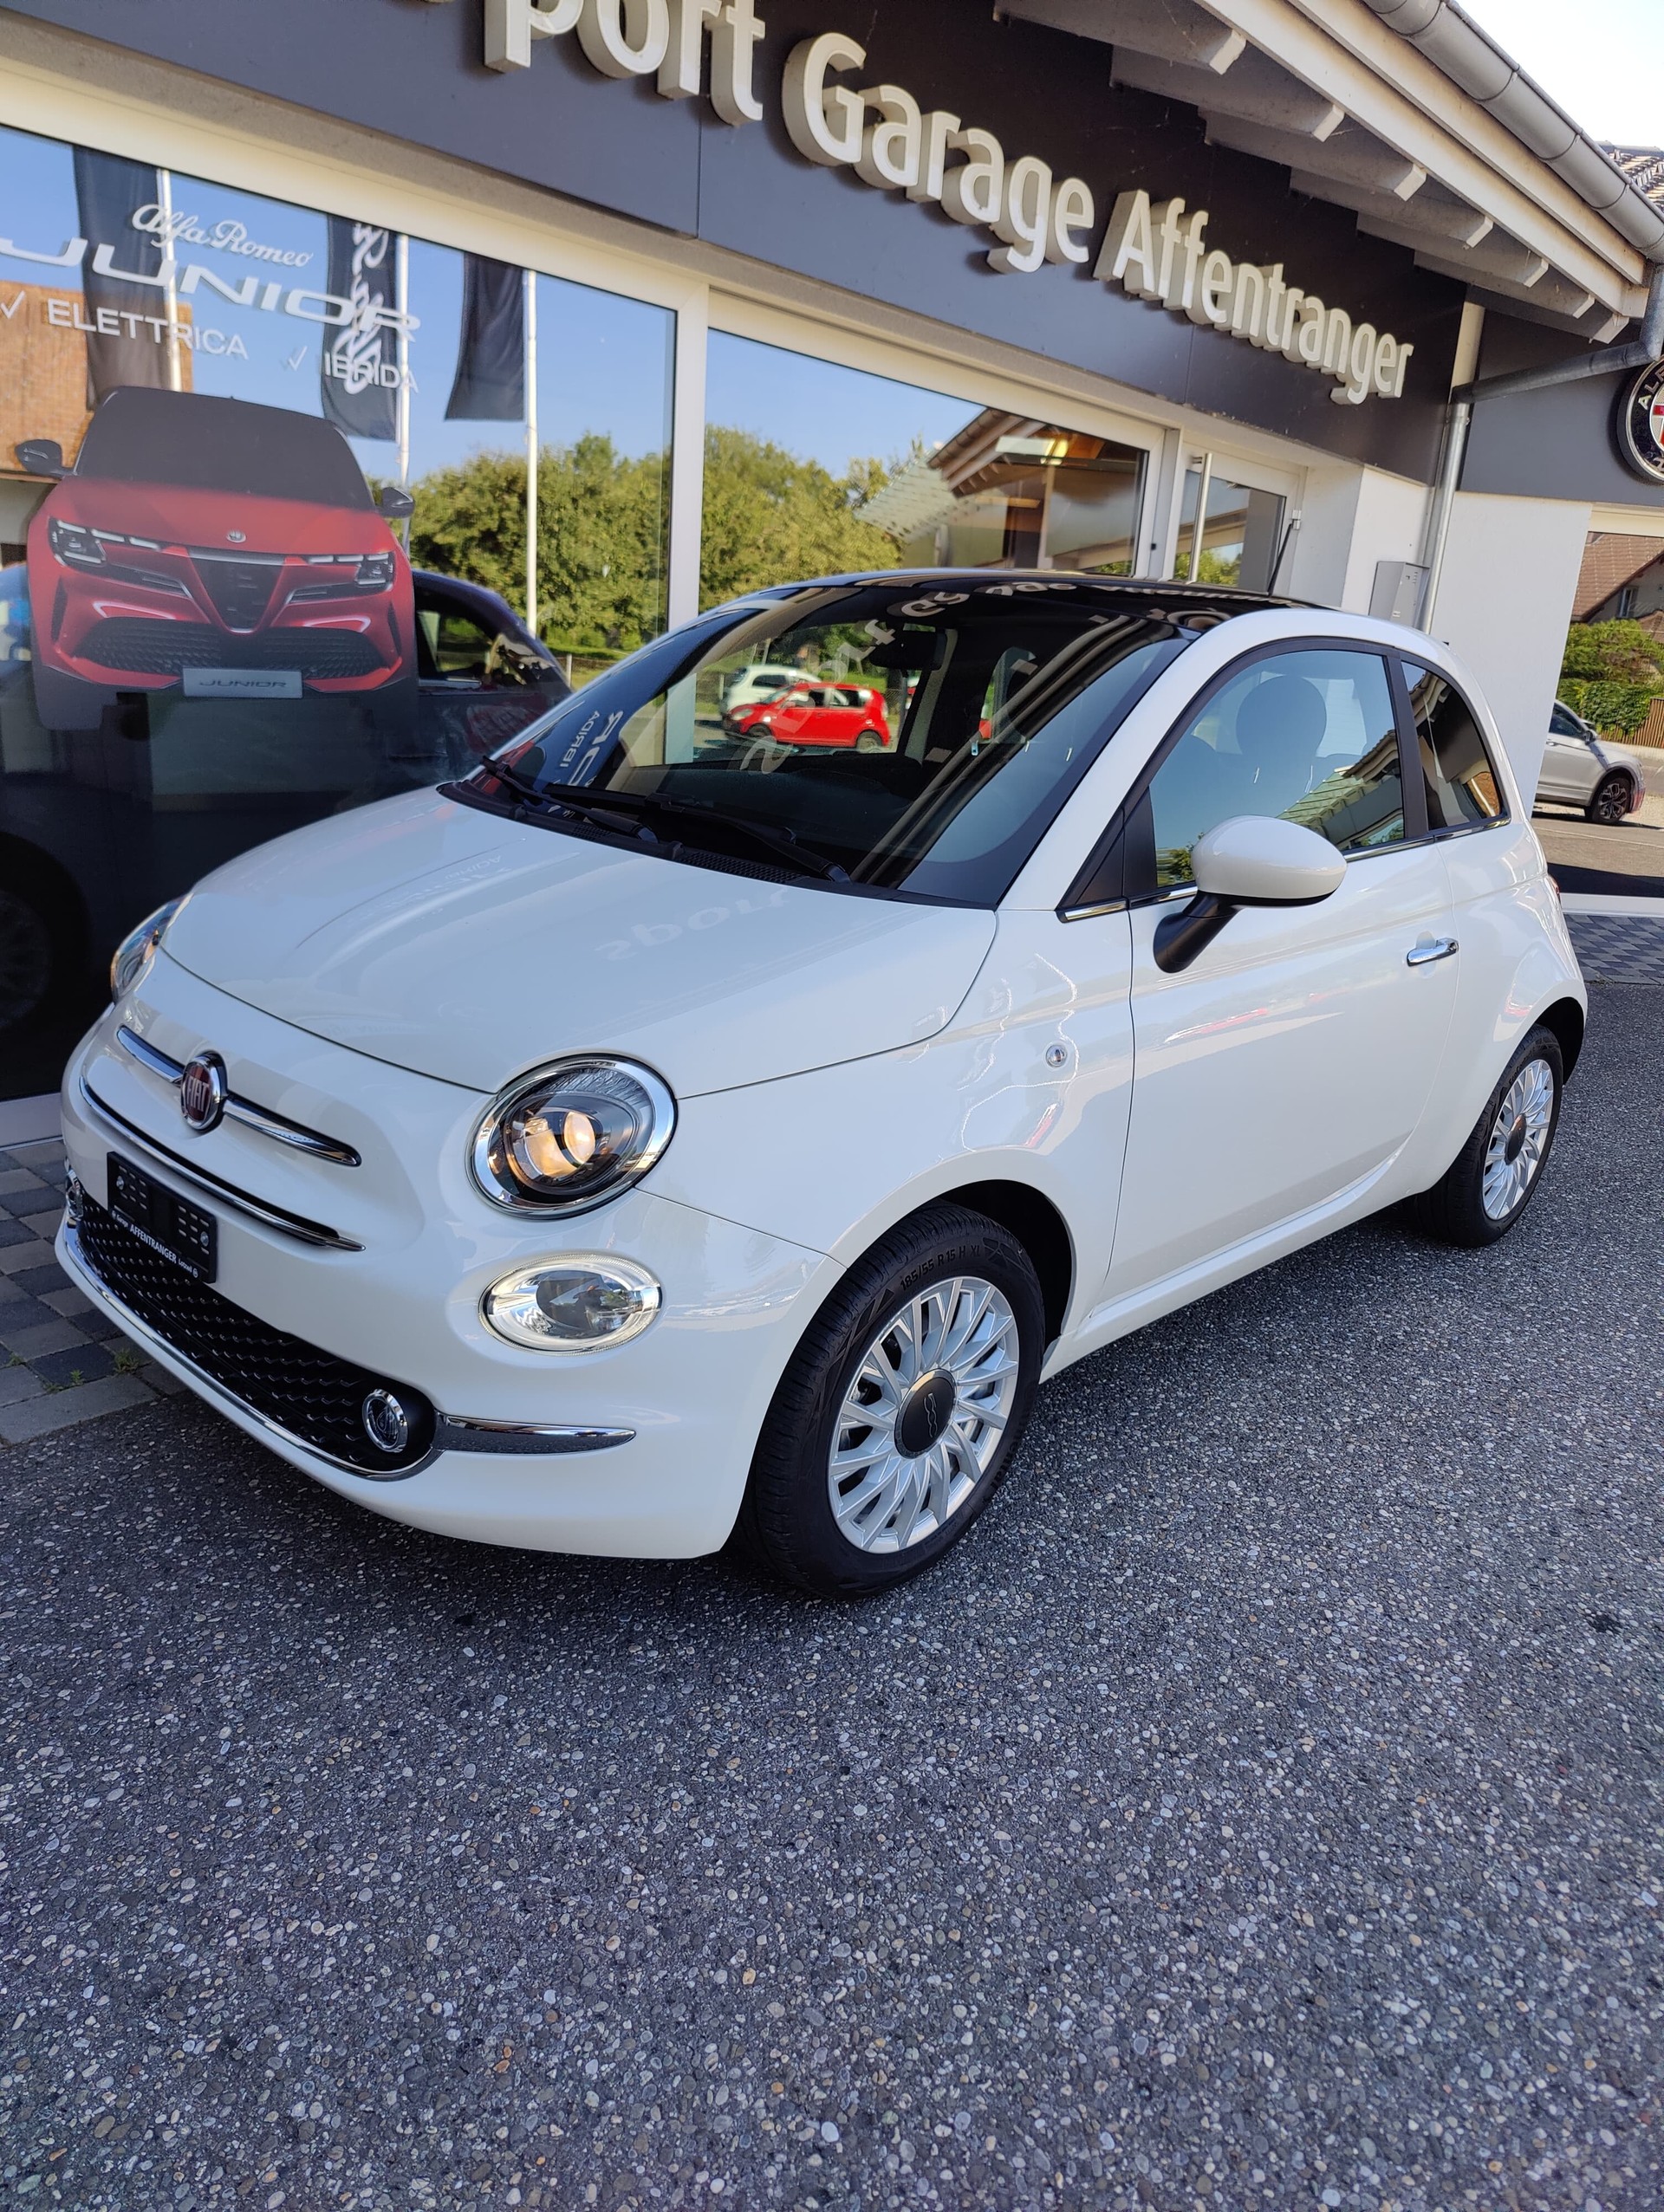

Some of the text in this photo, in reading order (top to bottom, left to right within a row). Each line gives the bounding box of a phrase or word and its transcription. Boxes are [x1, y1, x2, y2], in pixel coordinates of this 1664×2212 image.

[132, 204, 210, 248] Alfa
[208, 219, 315, 267] Romeo
[783, 33, 1094, 273] Garage
[1094, 190, 1414, 405] Affentranger
[0, 237, 421, 342] JUNIOR
[48, 298, 249, 360] ELETTRICA
[324, 351, 419, 393] IBRIDA
[198, 679, 287, 688] JUNIOR
[185, 1074, 210, 1112] FIAT
[129, 1223, 177, 1264] AFFENTRANGER
[900, 1258, 934, 1291] 185/55
[959, 1245, 966, 1258] H
[970, 1244, 981, 1256] XL
